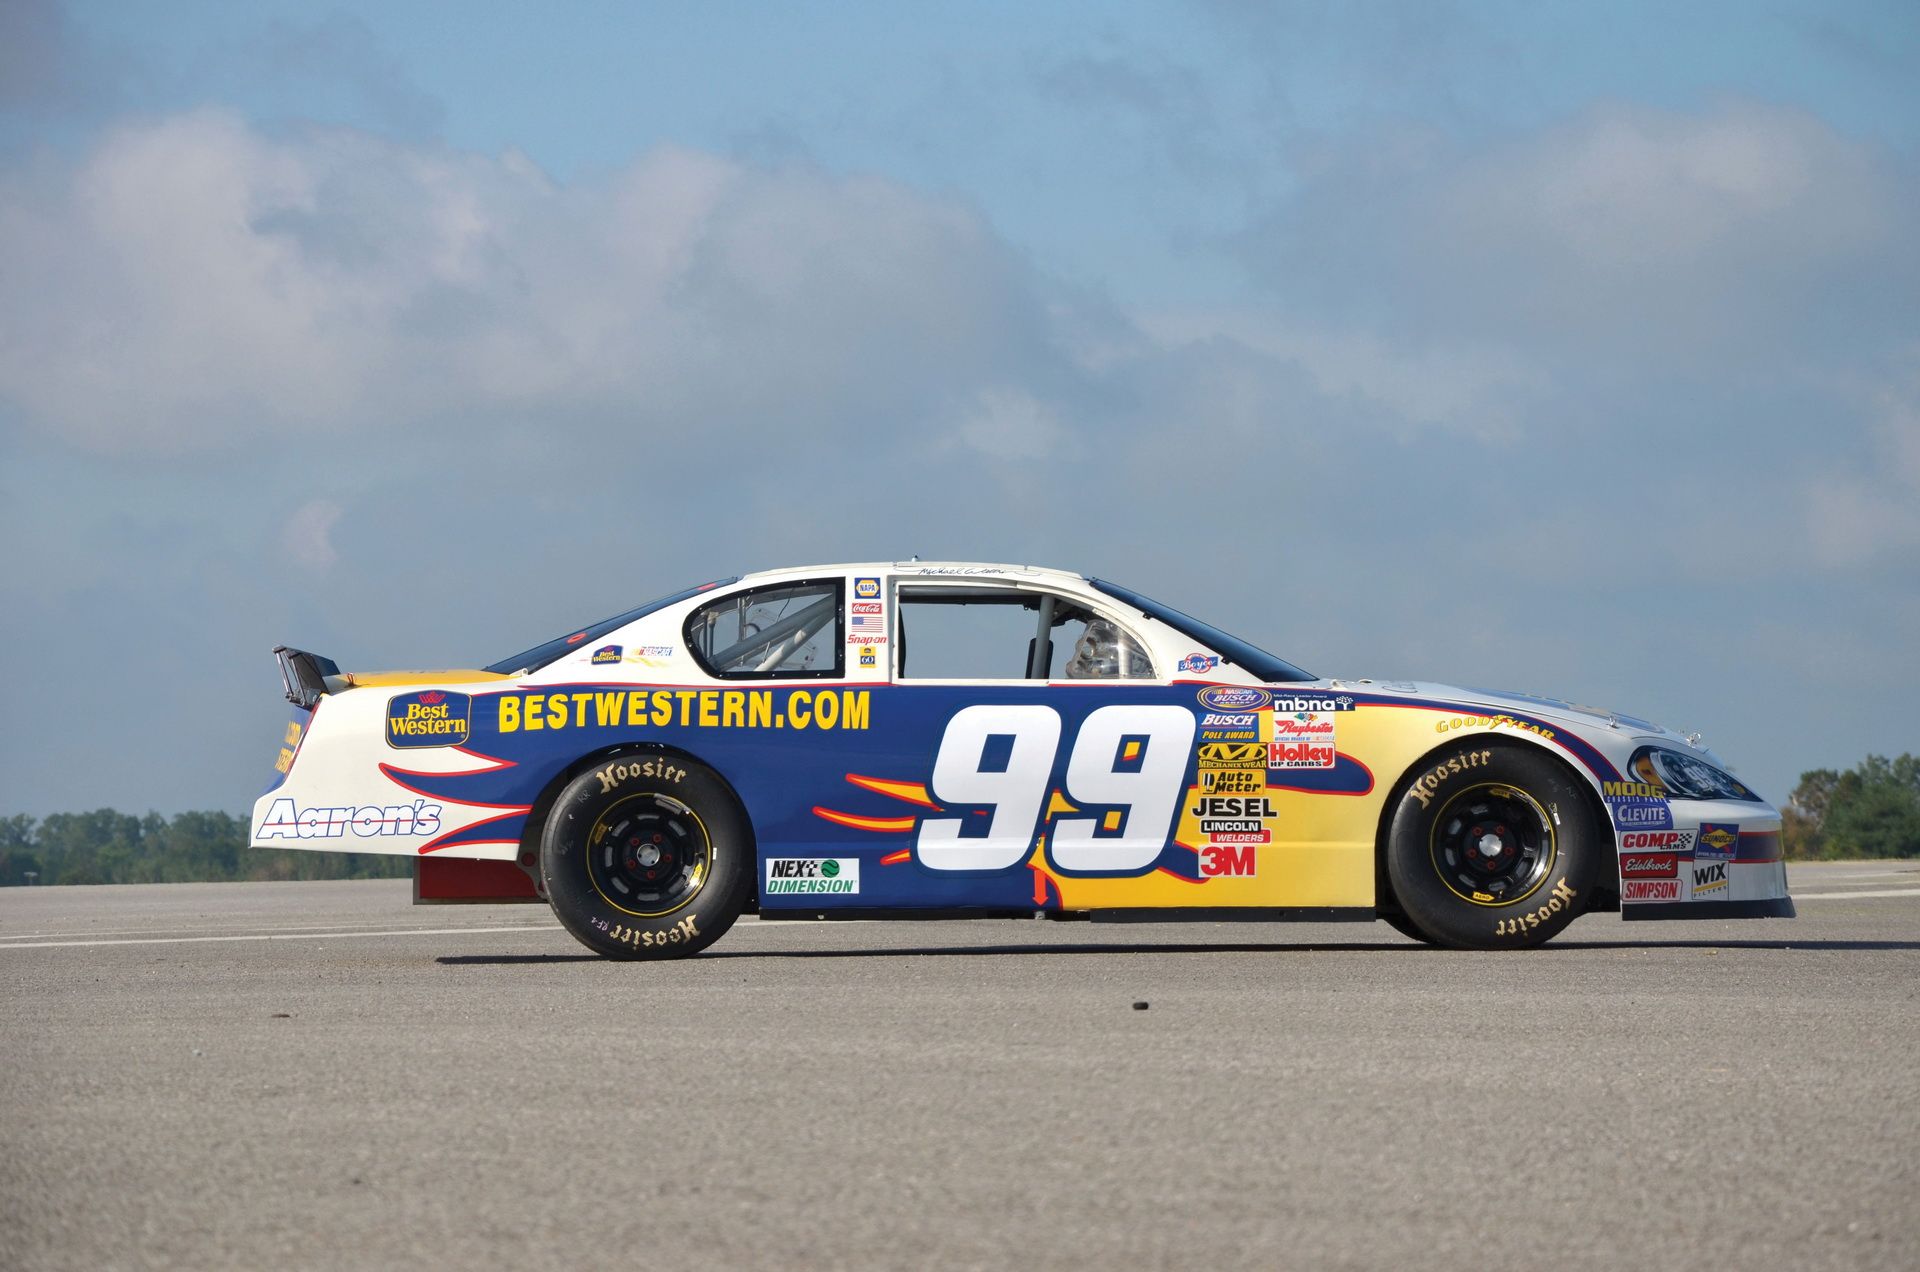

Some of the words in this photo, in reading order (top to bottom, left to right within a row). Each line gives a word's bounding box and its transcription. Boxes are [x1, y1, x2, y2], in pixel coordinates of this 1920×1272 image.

[860, 584, 876, 592] NAPA
[847, 634, 887, 645] Snap-on
[1213, 694, 1257, 702] BUSCH
[1274, 697, 1336, 711] mbna
[407, 703, 449, 719] Best
[499, 690, 870, 733] BESTWESTERN.COM
[390, 714, 467, 736] Western
[1201, 713, 1257, 726] BUSCH
[1202, 731, 1222, 739] POLE
[1224, 731, 1255, 739] AWARD
[1274, 720, 1334, 736] Raybestos
[1270, 743, 1334, 767] Holley
[1199, 760, 1242, 768] MECHANIX
[1243, 760, 1267, 768] WEAR
[596, 757, 687, 794] Hoosier
[1217, 772, 1253, 782] Auto
[1410, 750, 1491, 810] Hoosier
[917, 705, 1196, 871] 99
[1214, 782, 1261, 792] Meter
[1603, 781, 1665, 798] MOOG
[1192, 798, 1277, 817] JESEL
[1617, 805, 1666, 822] CLEVITE
[256, 798, 442, 839] Aaron's
[1204, 822, 1259, 832] LINCOLN
[1216, 834, 1264, 842] WELDERS
[1623, 833, 1679, 849] COMP
[1701, 834, 1736, 843] SUNOCO
[1200, 846, 1255, 876] 3M
[1625, 857, 1672, 872] Edelbrock
[1694, 863, 1727, 886] WIX
[767, 880, 853, 893] DIMENSION
[1625, 882, 1678, 898] SIMPSON
[1694, 885, 1727, 898] FILTERS
[1496, 876, 1577, 937] Hoosier
[609, 914, 700, 951] Hoosier
